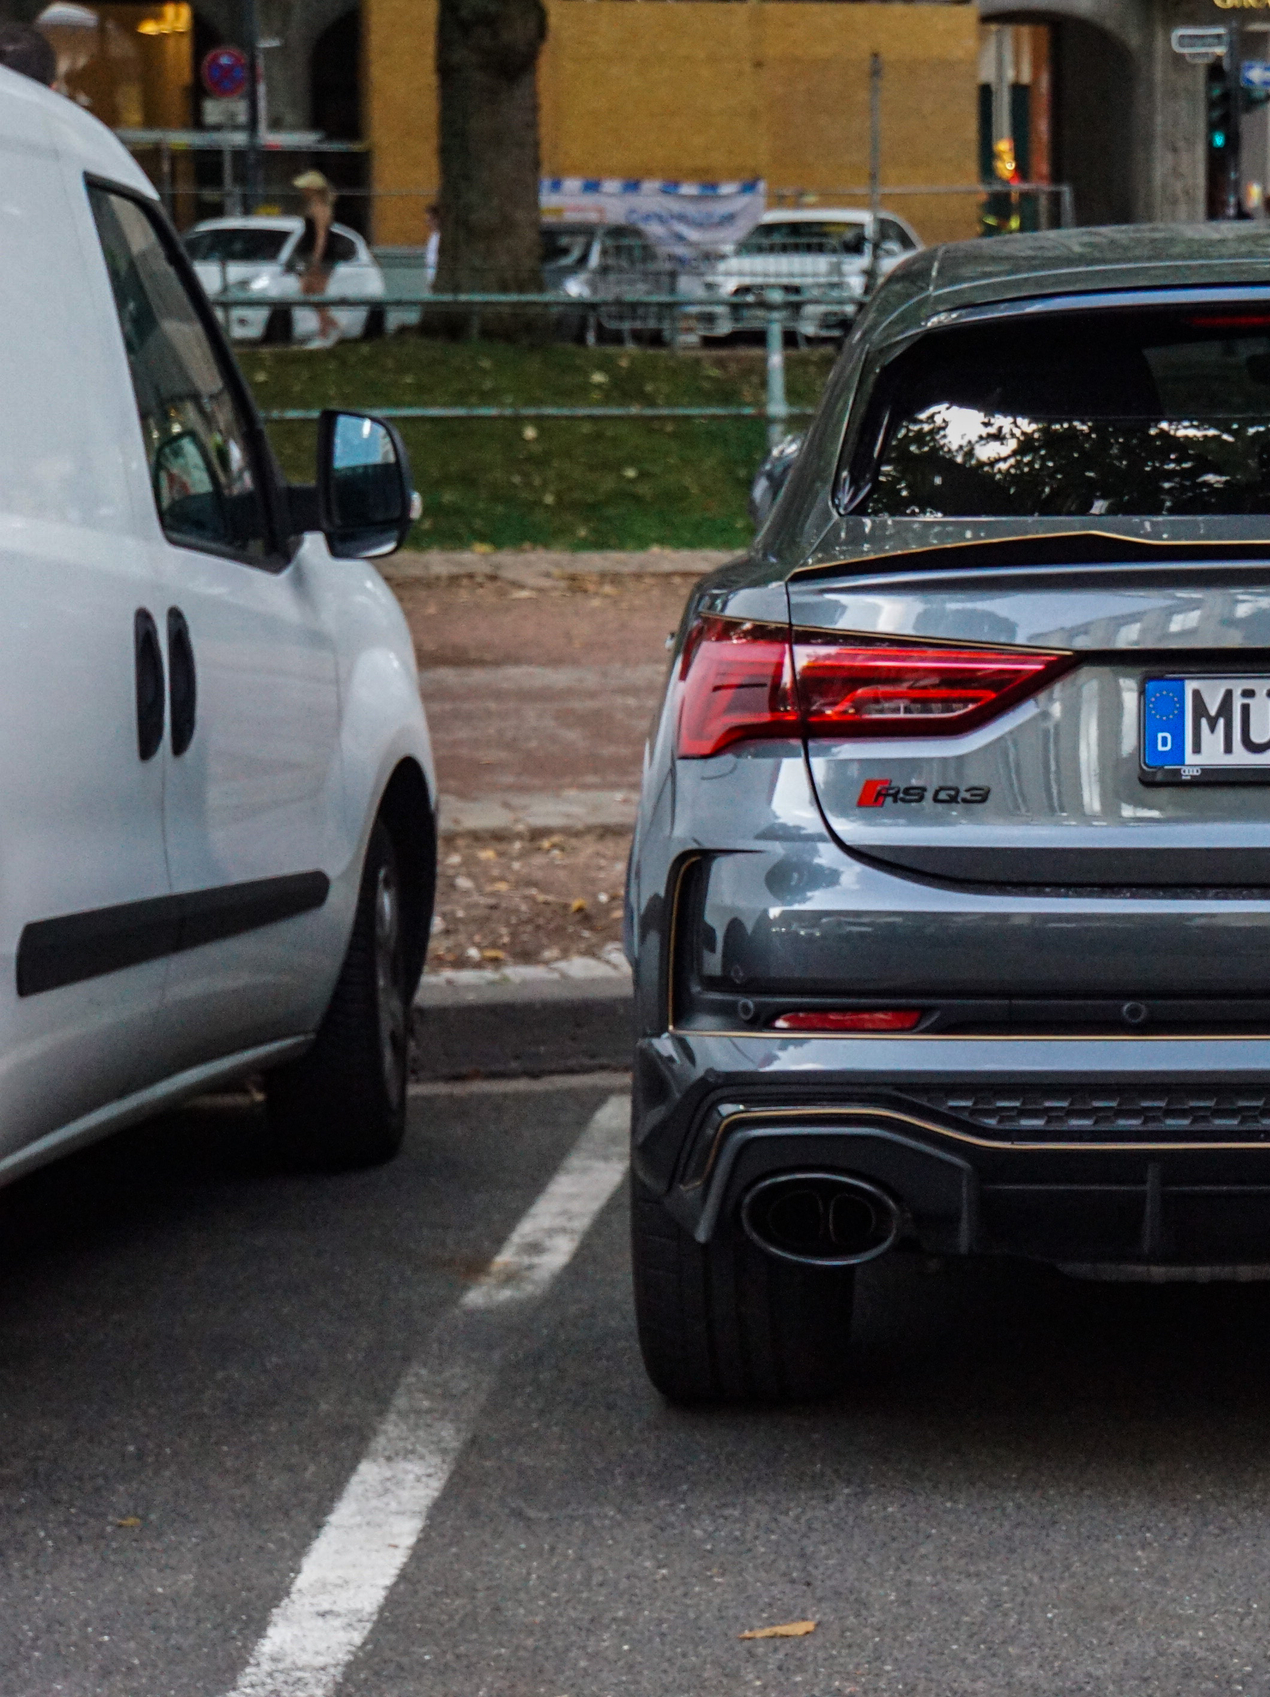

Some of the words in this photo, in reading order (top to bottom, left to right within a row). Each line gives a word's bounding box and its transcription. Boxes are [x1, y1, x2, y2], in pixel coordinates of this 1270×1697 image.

[1157, 732, 1172, 752] D
[873, 785, 927, 804] RS
[932, 785, 991, 804] Q3
